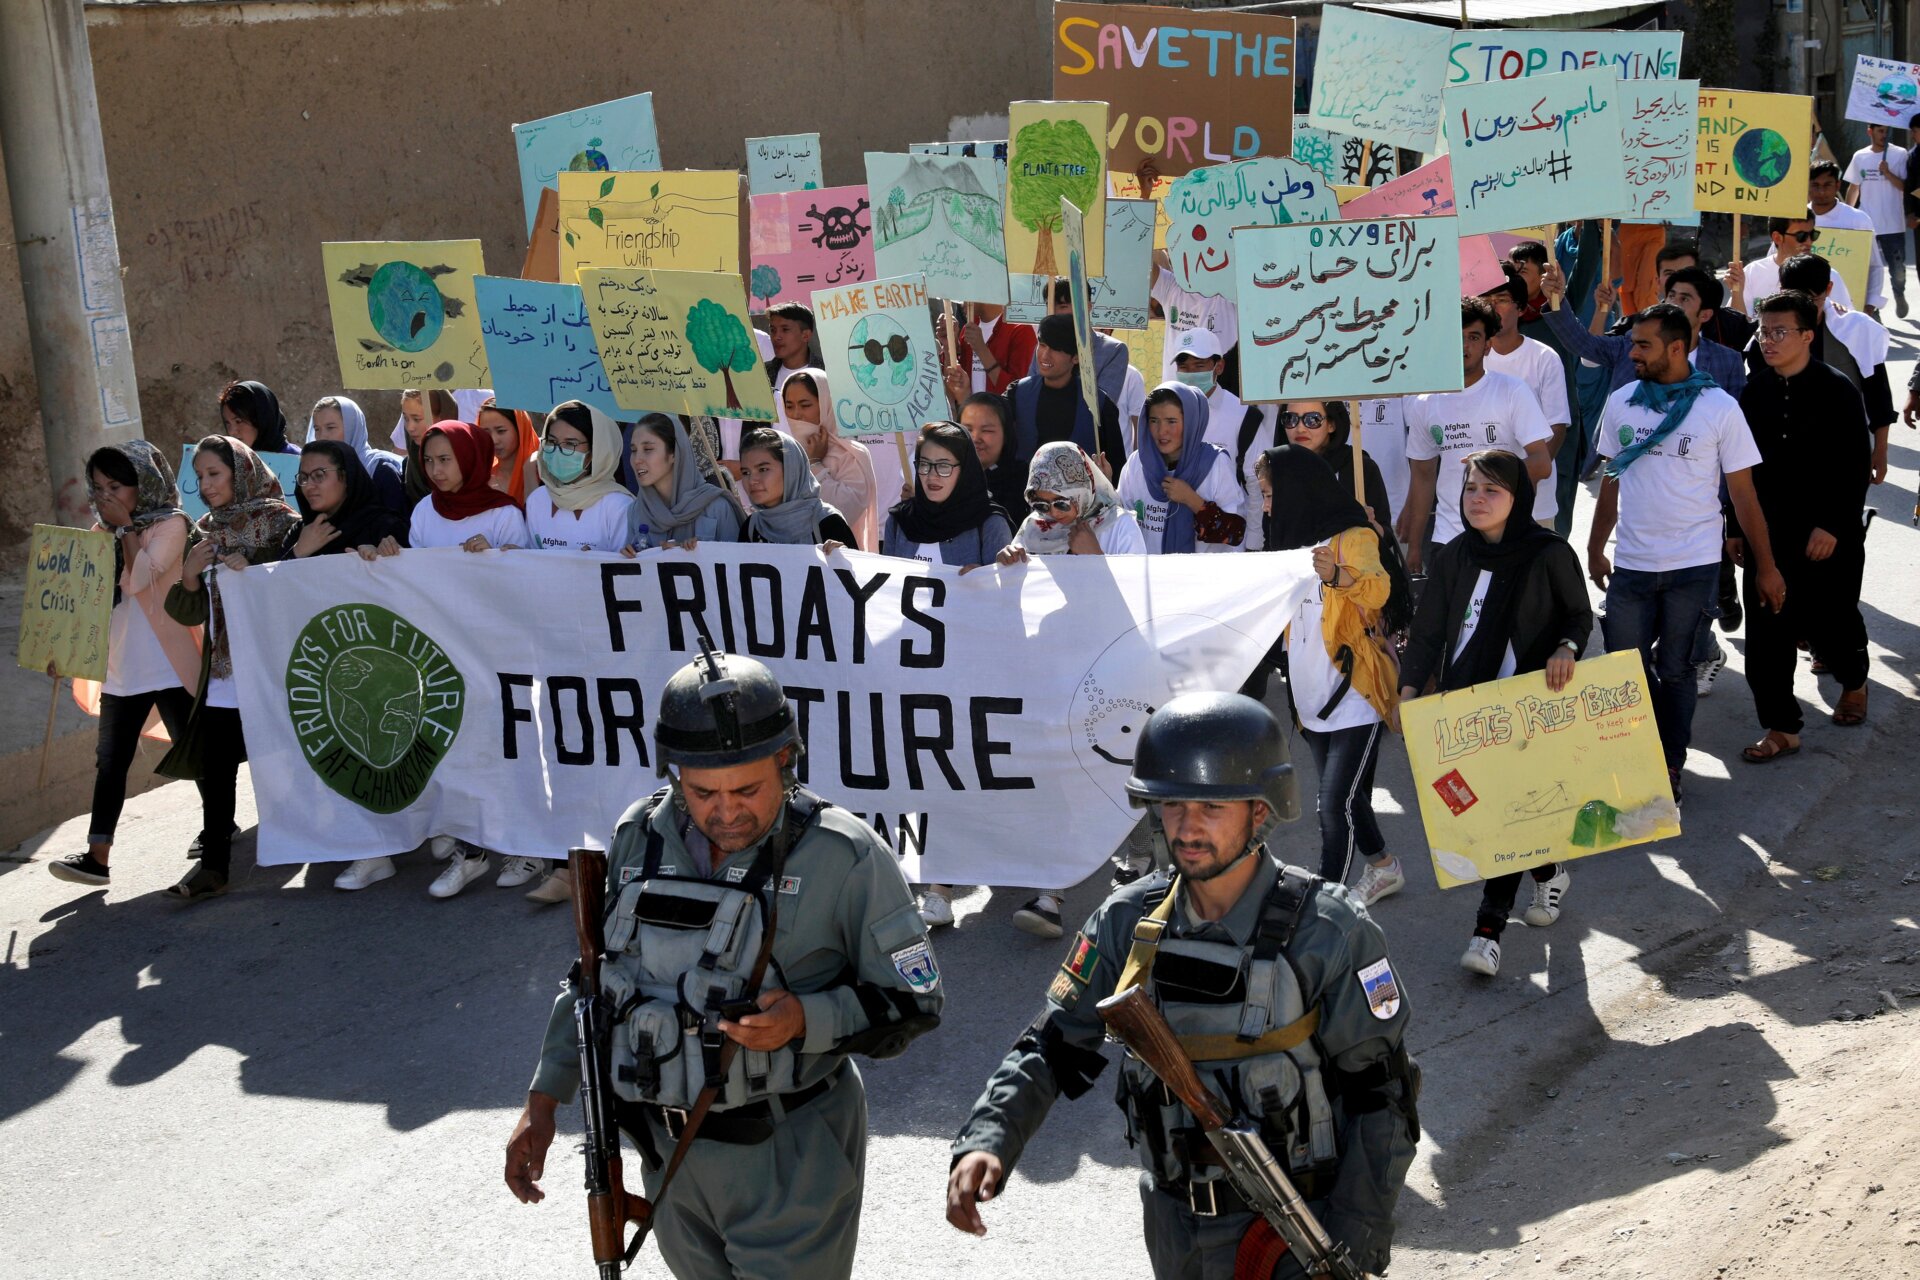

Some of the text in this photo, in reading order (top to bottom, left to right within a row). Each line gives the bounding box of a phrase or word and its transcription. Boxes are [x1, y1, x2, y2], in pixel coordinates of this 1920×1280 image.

[1059, 17, 1293, 78] SAVE THE
[1450, 42, 1548, 82] STOP
[1728, 98, 1733, 109] I
[1698, 116, 1748, 136] AND
[1707, 139, 1719, 153] IS
[1023, 163, 1052, 176] PLANT
[1062, 164, 1087, 176] TREE
[1724, 163, 1728, 175] I
[606, 223, 680, 257] Friendship
[624, 249, 653, 267] with
[826, 251, 865, 284] زندگی
[1366, 236, 1436, 282] برای
[1253, 250, 1359, 291] حمایت
[503, 294, 537, 317] محیط
[820, 283, 927, 321] MAKE EARTH
[1402, 288, 1431, 336] از
[541, 304, 556, 324] از
[1335, 296, 1400, 333] محیط
[544, 332, 555, 347] از
[565, 335, 576, 352] را
[400, 360, 415, 369] on
[836, 351, 940, 431] COOL AGAIN
[1444, 423, 1470, 432] Afghan
[1445, 433, 1467, 441] Youth
[1636, 427, 1655, 436] Afgh
[1453, 442, 1474, 450] Action
[542, 537, 568, 547] Afghan
[600, 562, 945, 668] FRIDAYS
[289, 609, 460, 758] FRIDAYS FOR FUTURE
[497, 672, 650, 769] FOR
